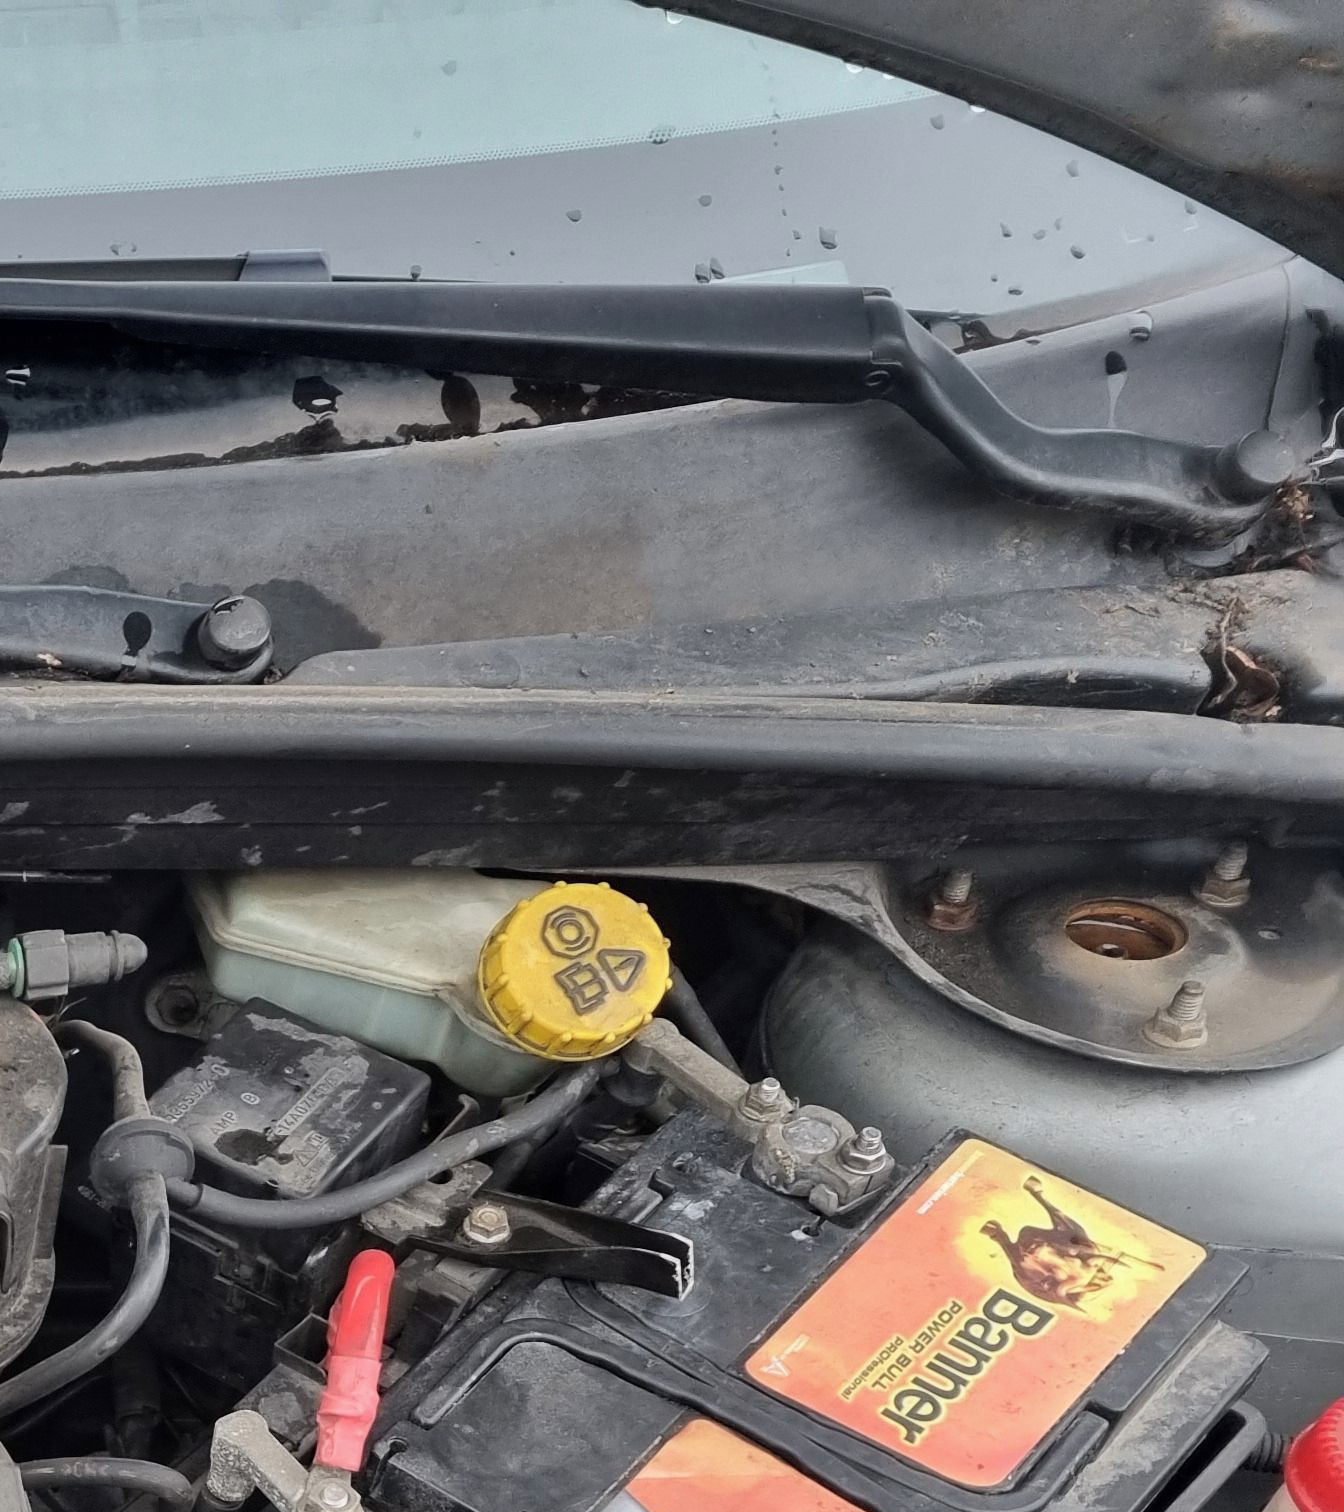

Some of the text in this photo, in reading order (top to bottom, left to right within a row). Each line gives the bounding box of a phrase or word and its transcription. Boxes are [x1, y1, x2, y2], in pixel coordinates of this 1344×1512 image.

[211, 1110, 237, 1136] AMP
[841, 1336, 904, 1400] PROfessional
[871, 1300, 963, 1389] POWER BULL
[880, 1288, 1056, 1444] Banner
